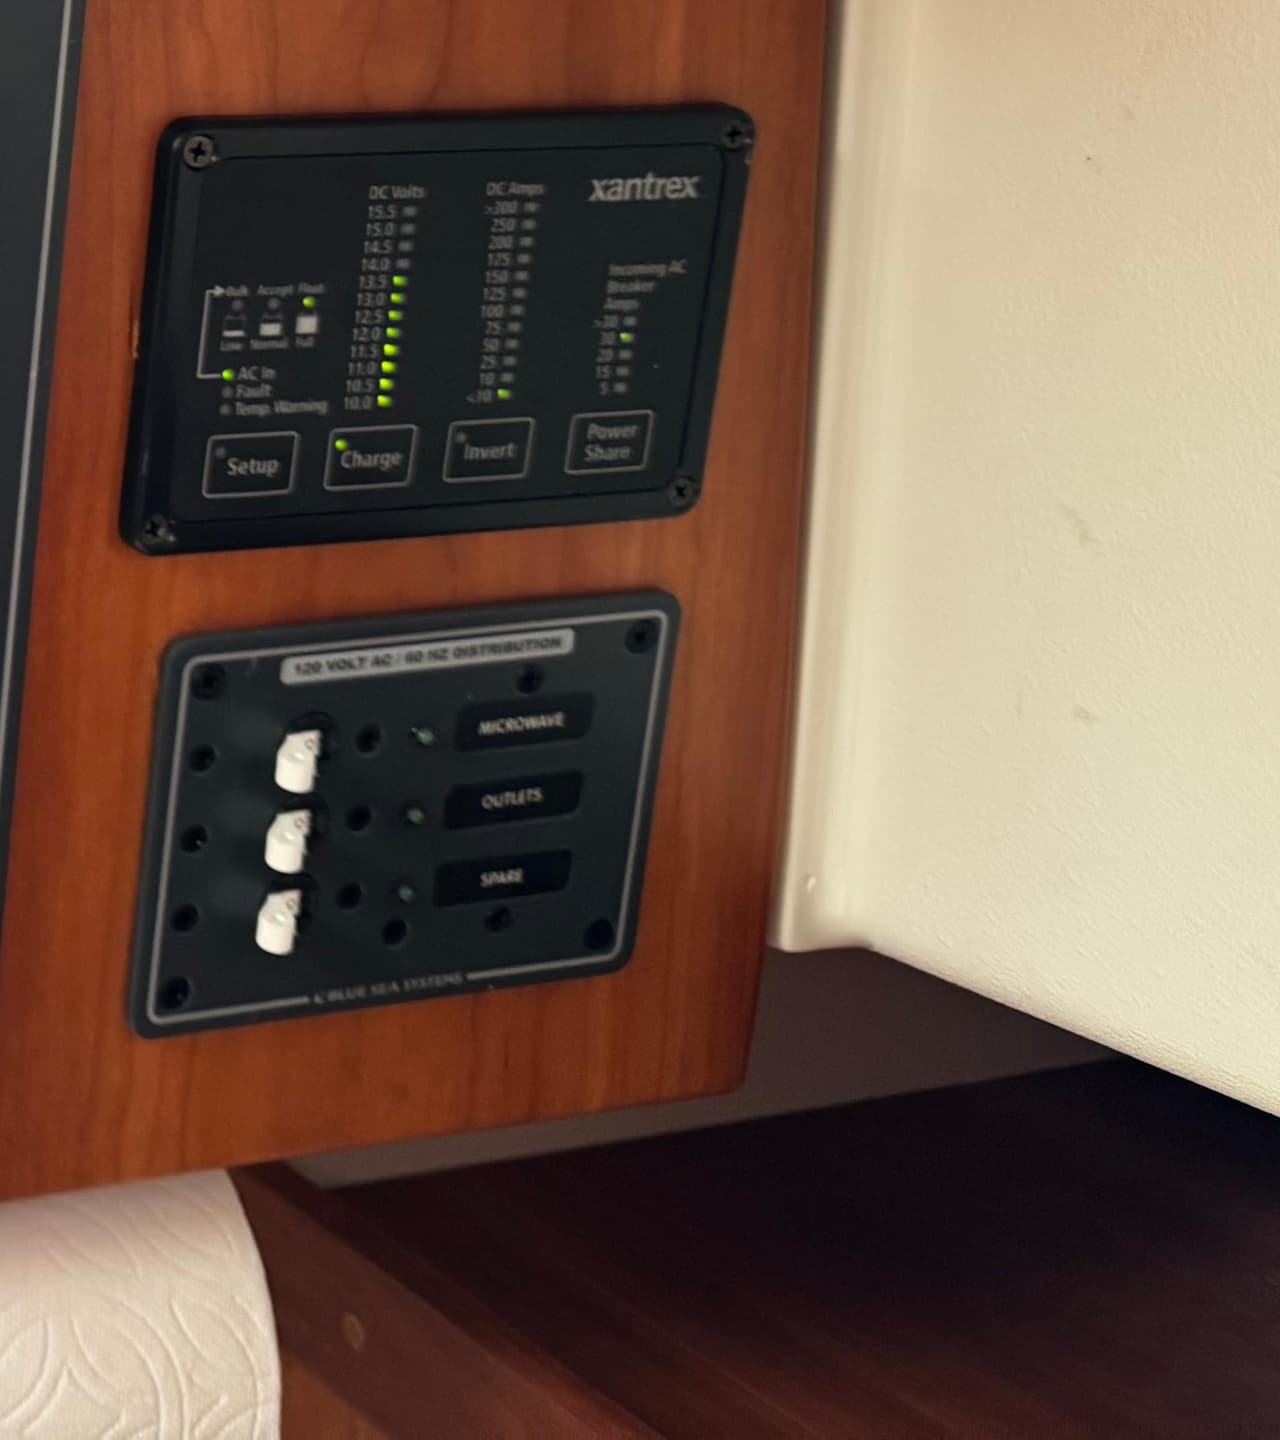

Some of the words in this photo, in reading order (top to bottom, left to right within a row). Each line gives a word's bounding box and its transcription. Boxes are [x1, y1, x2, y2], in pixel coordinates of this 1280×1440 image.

[589, 172, 701, 202] xantrex
[587, 422, 637, 441] Power
[341, 449, 402, 470] Charge
[464, 442, 516, 460] Invert
[584, 443, 632, 461] Share
[228, 456, 280, 478] Setup
[479, 712, 565, 735] MICROWAVE
